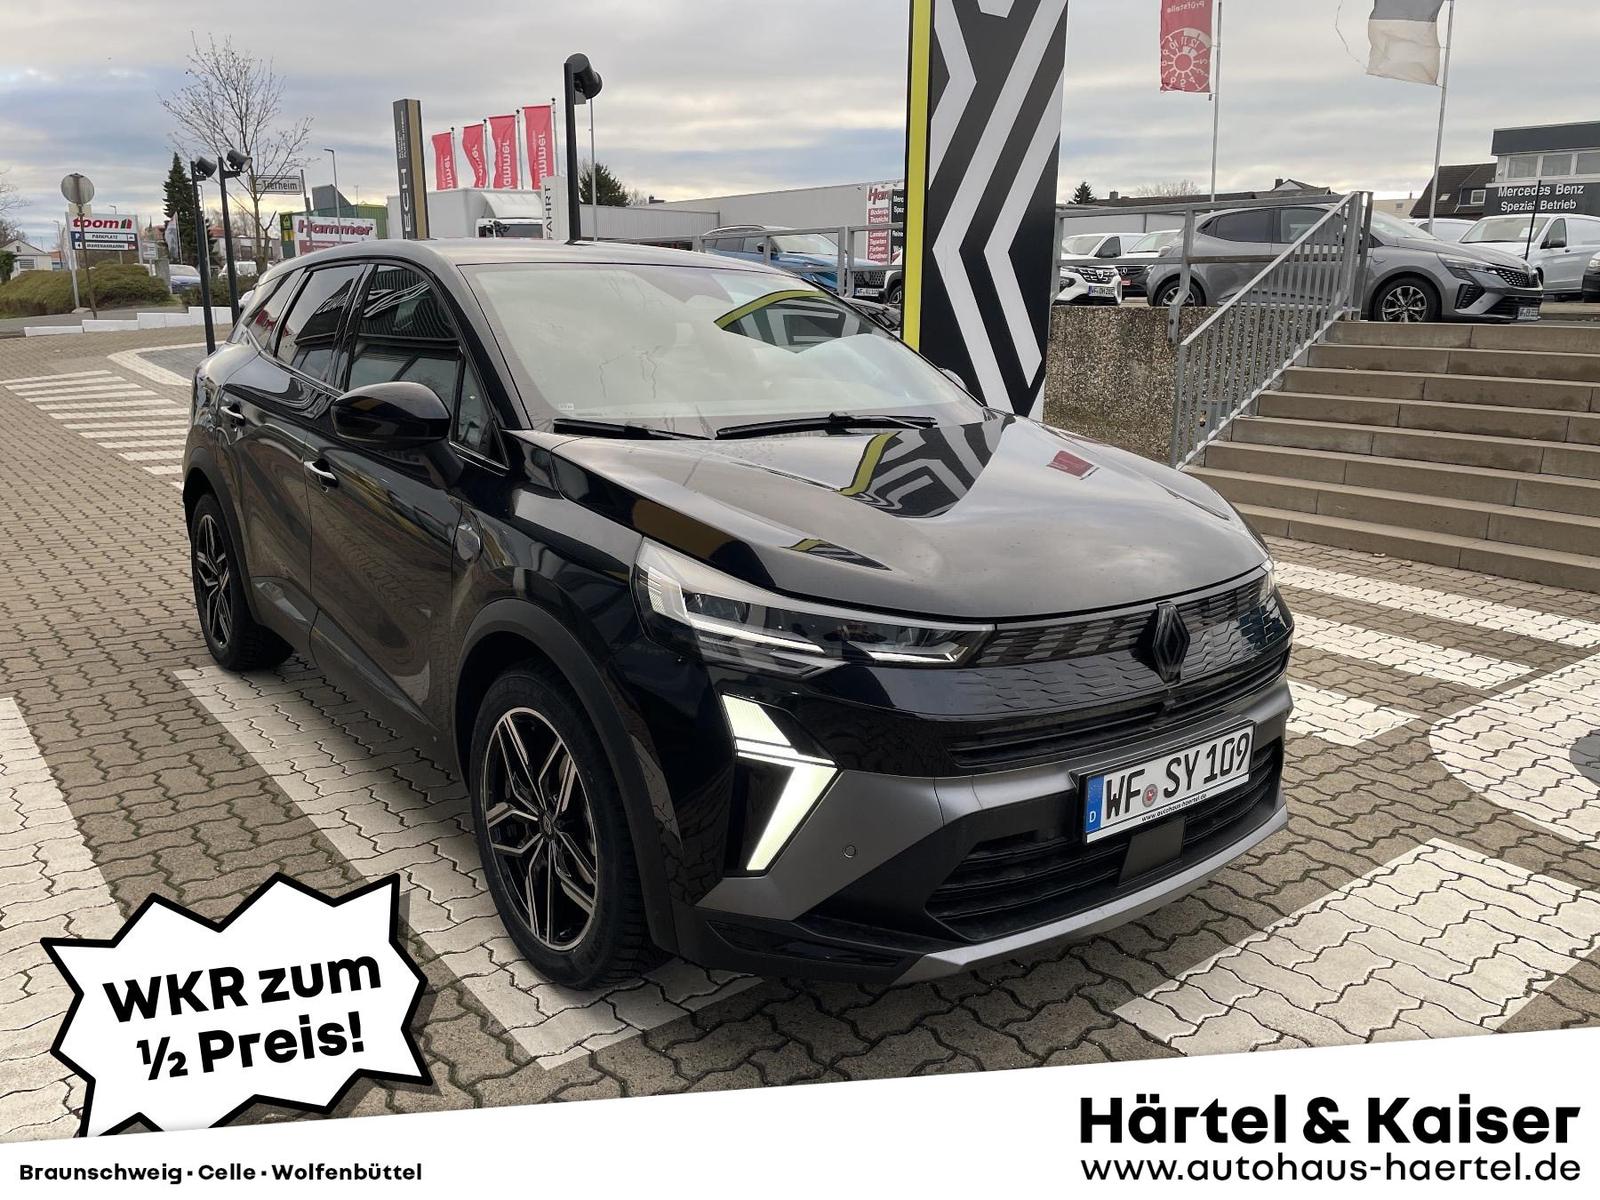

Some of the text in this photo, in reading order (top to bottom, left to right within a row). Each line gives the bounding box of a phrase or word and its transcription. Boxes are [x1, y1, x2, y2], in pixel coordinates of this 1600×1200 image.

[1497, 183, 1585, 198] Mercedes Benz
[1540, 199, 1577, 210] Betrieb
[73, 217, 119, 229] toom
[298, 220, 373, 236] Hammer
[1106, 732, 1250, 820] WF SY 109
[1089, 810, 1096, 823] D
